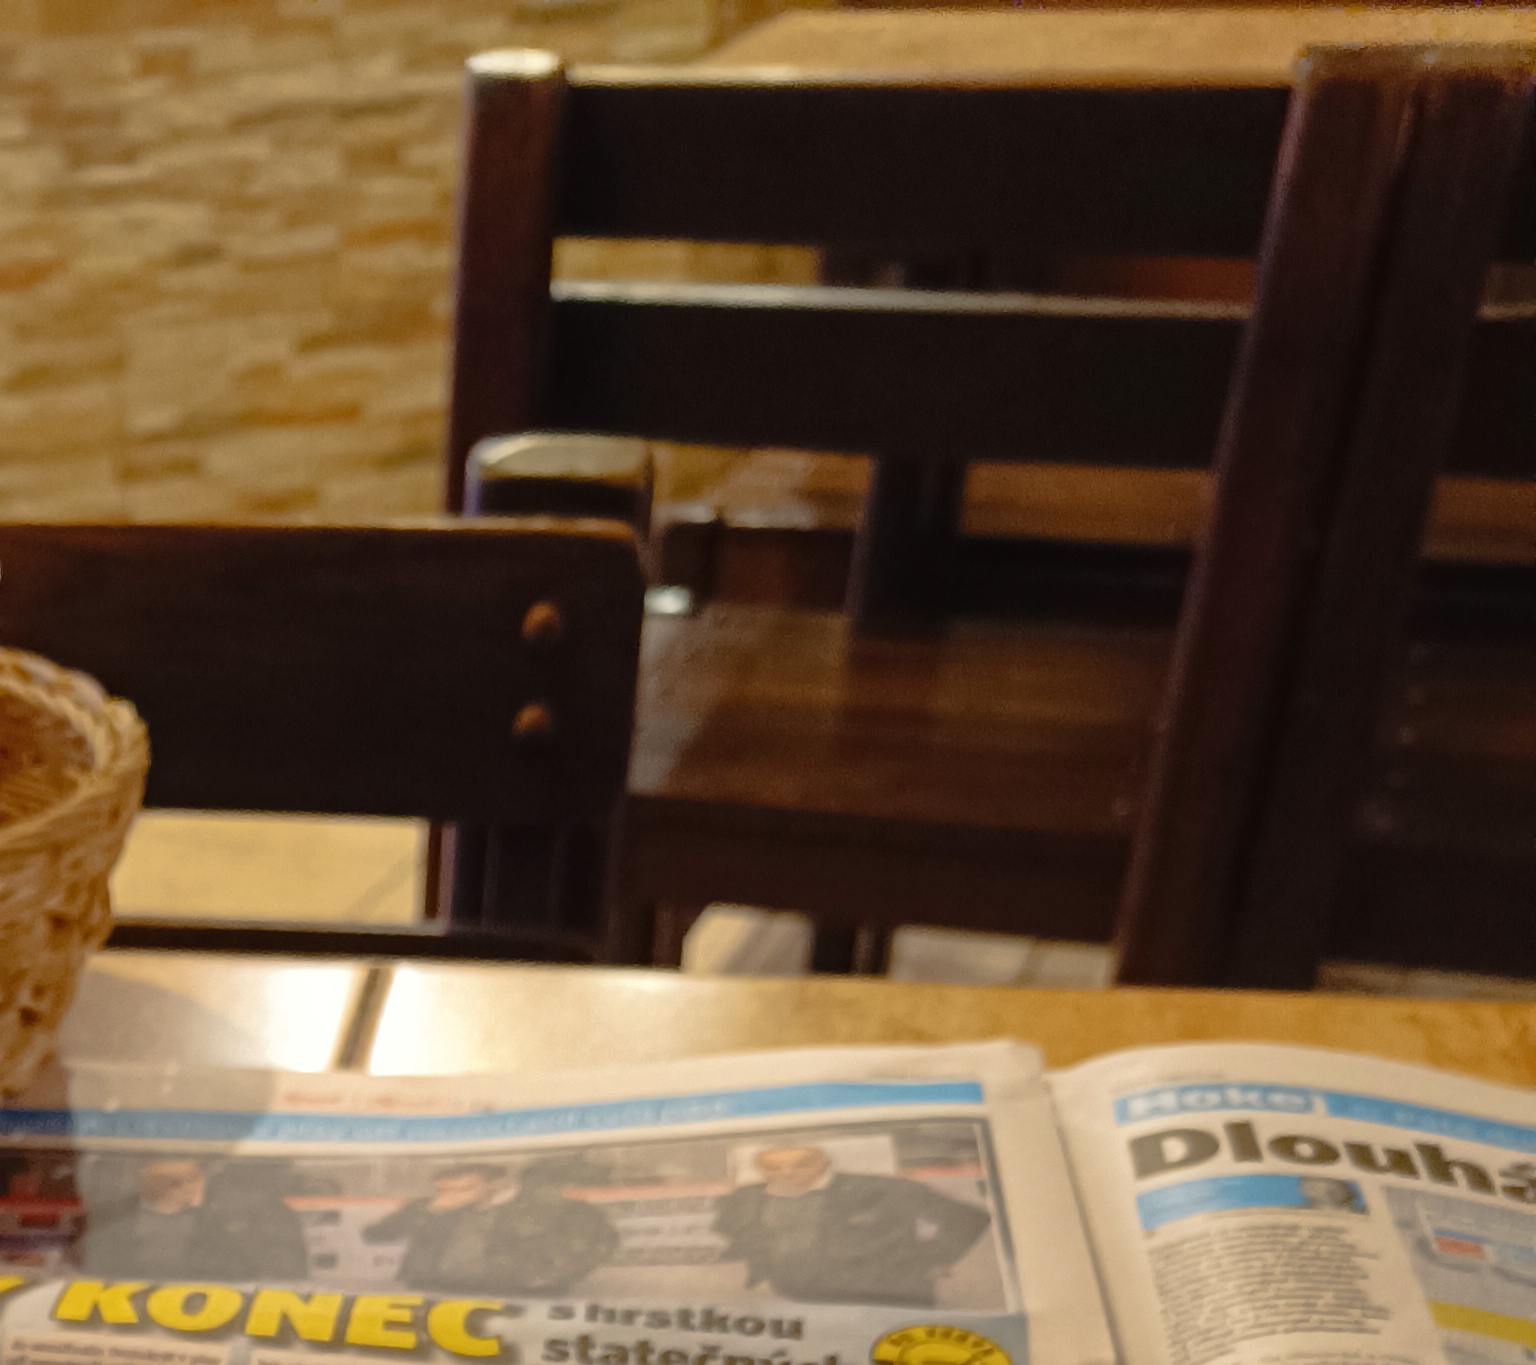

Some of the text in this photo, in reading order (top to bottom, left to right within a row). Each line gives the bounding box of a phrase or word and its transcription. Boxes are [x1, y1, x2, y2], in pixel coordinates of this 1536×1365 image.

[56, 1280, 502, 1356] KONEC
[547, 1304, 805, 1340] s hrstkou
